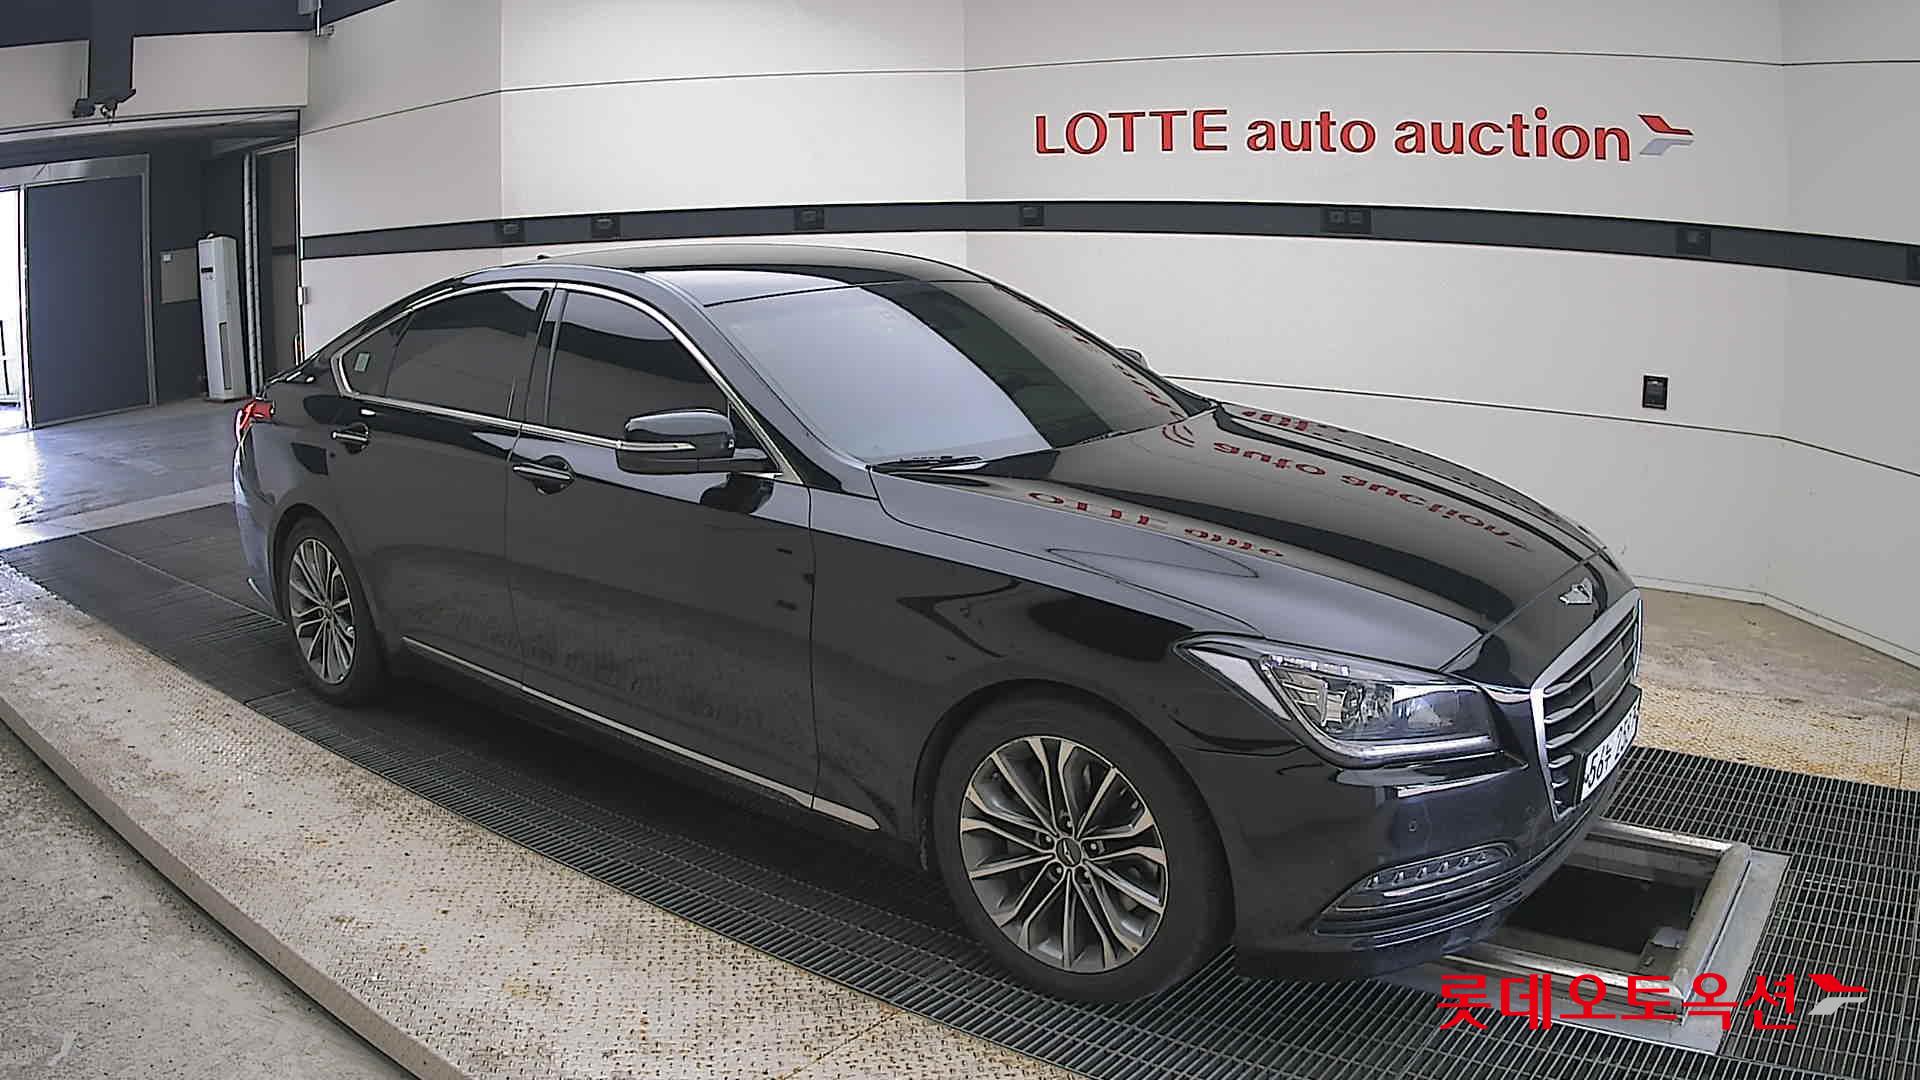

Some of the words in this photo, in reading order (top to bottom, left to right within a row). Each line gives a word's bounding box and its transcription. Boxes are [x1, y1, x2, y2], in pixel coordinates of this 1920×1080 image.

[1035, 108, 1229, 156] LOTTE
[1246, 111, 1377, 154] auto
[1393, 106, 1632, 162] auction
